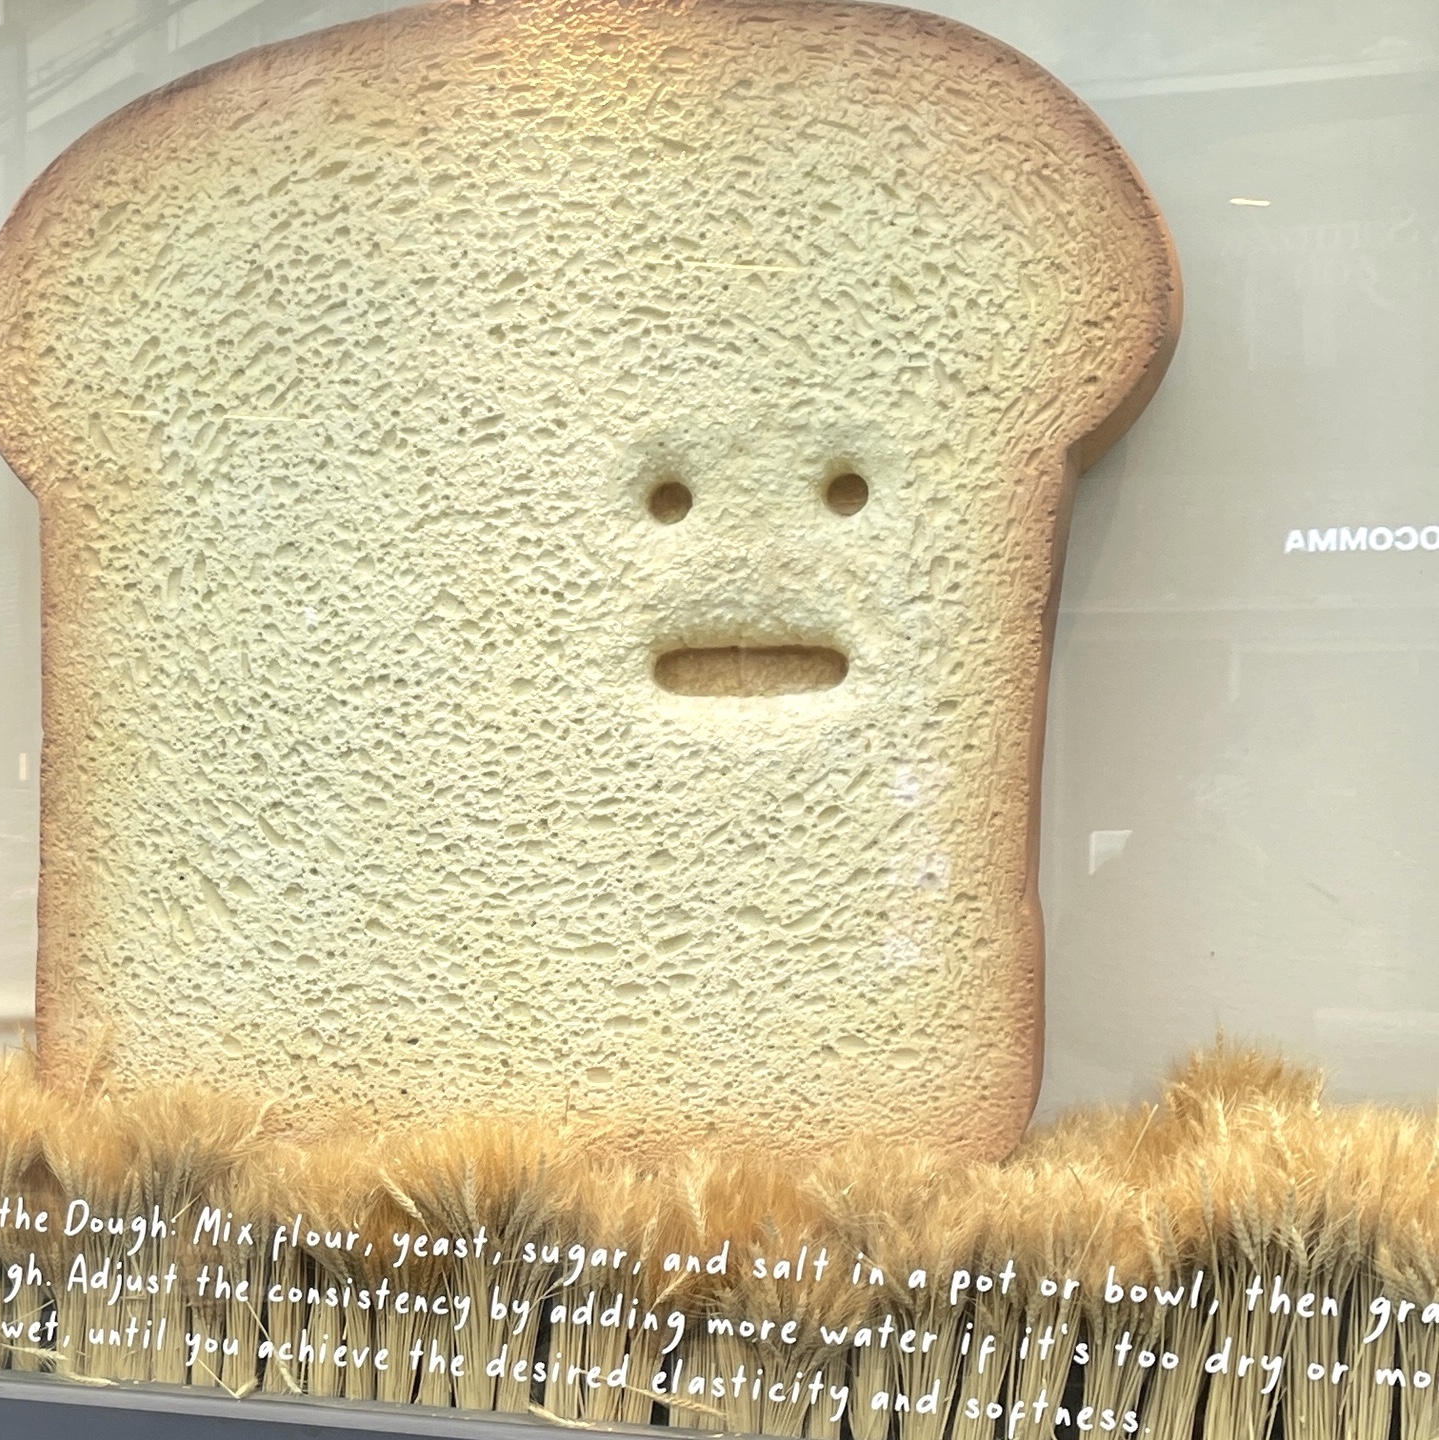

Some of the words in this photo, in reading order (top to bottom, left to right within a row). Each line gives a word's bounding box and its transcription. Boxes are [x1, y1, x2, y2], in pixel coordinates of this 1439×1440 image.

[63, 1199, 177, 1257] Dough:
[193, 1206, 253, 1246] Mix
[272, 1213, 373, 1261] flour,
[393, 1226, 501, 1268] yeast,
[522, 1242, 641, 1287] sugar,
[663, 1240, 730, 1275] and
[752, 1245, 829, 1281] salt
[852, 1252, 884, 1286] in
[908, 1269, 927, 1289] a
[950, 1259, 1016, 1306] pot
[1040, 1278, 1080, 1300] or
[1104, 1265, 1219, 1316] bowl,
[1245, 1275, 1338, 1318] then
[1362, 1296, 1439, 1344] gra
[67, 1248, 178, 1306] Adjust
[196, 1265, 249, 1302] the
[268, 1277, 471, 1337] consistency
[490, 1285, 530, 1336] by
[550, 1290, 685, 1359] adding
[707, 1318, 797, 1344] more
[820, 1314, 938, 1353] water
[961, 1322, 996, 1375] if
[1020, 1323, 1090, 1365] it's
[1115, 1331, 1179, 1369] too
[1204, 1336, 1283, 1395] dry
[1307, 1361, 1349, 1384] or
[1375, 1368, 1432, 1389] mo
[1, 1310, 71, 1348] wet,
[88, 1316, 166, 1351] until
[185, 1332, 239, 1367] you
[258, 1328, 389, 1375] achieve
[409, 1338, 465, 1377] the
[486, 1343, 629, 1389] desired
[651, 1358, 849, 1422] elasticity
[870, 1378, 941, 1415] and
[964, 1388, 1151, 1440] softness.
